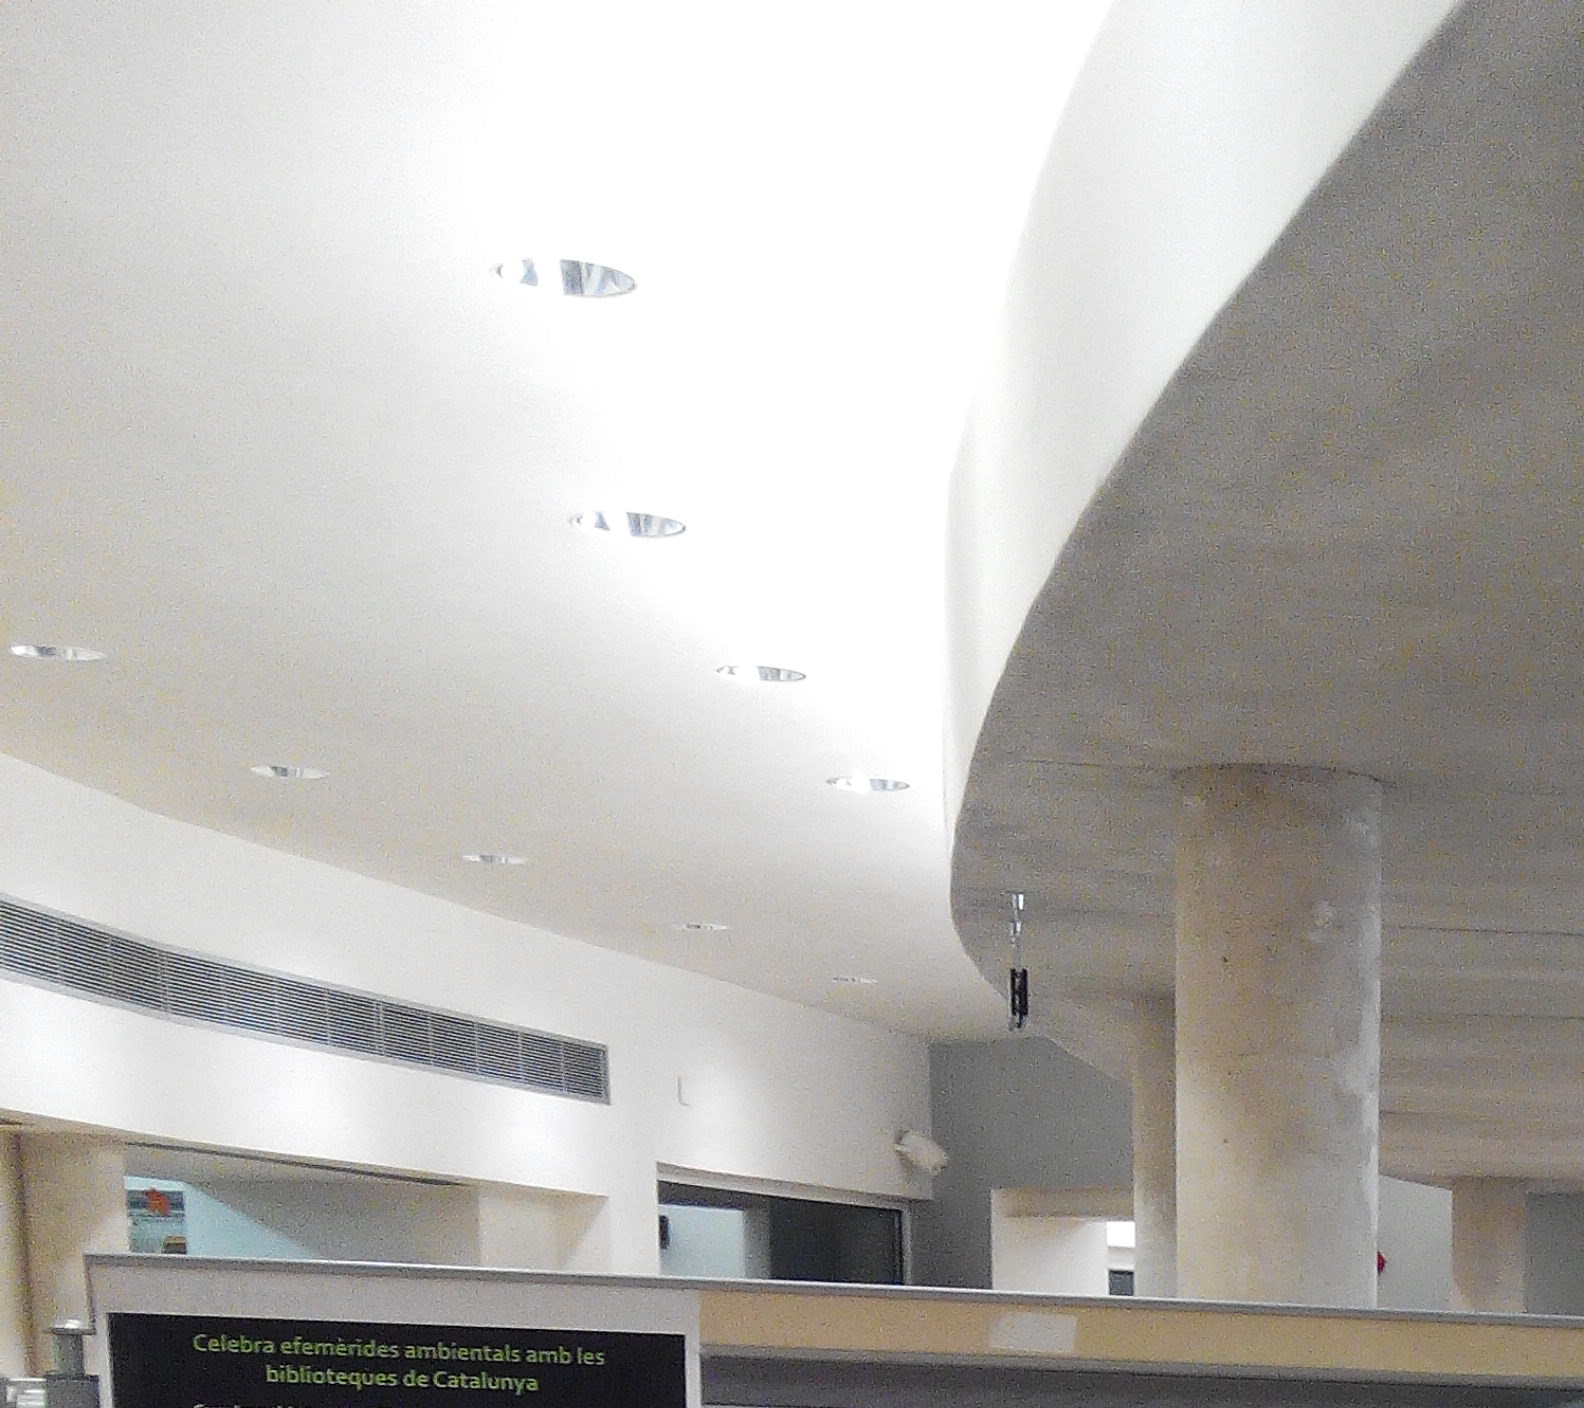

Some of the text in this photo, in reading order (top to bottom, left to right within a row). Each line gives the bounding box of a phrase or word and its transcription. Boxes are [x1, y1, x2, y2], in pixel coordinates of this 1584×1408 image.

[193, 1334, 605, 1366] Celebra efemèrides ambientals amb les
[266, 1365, 539, 1395] biblioteques de Catalunya
